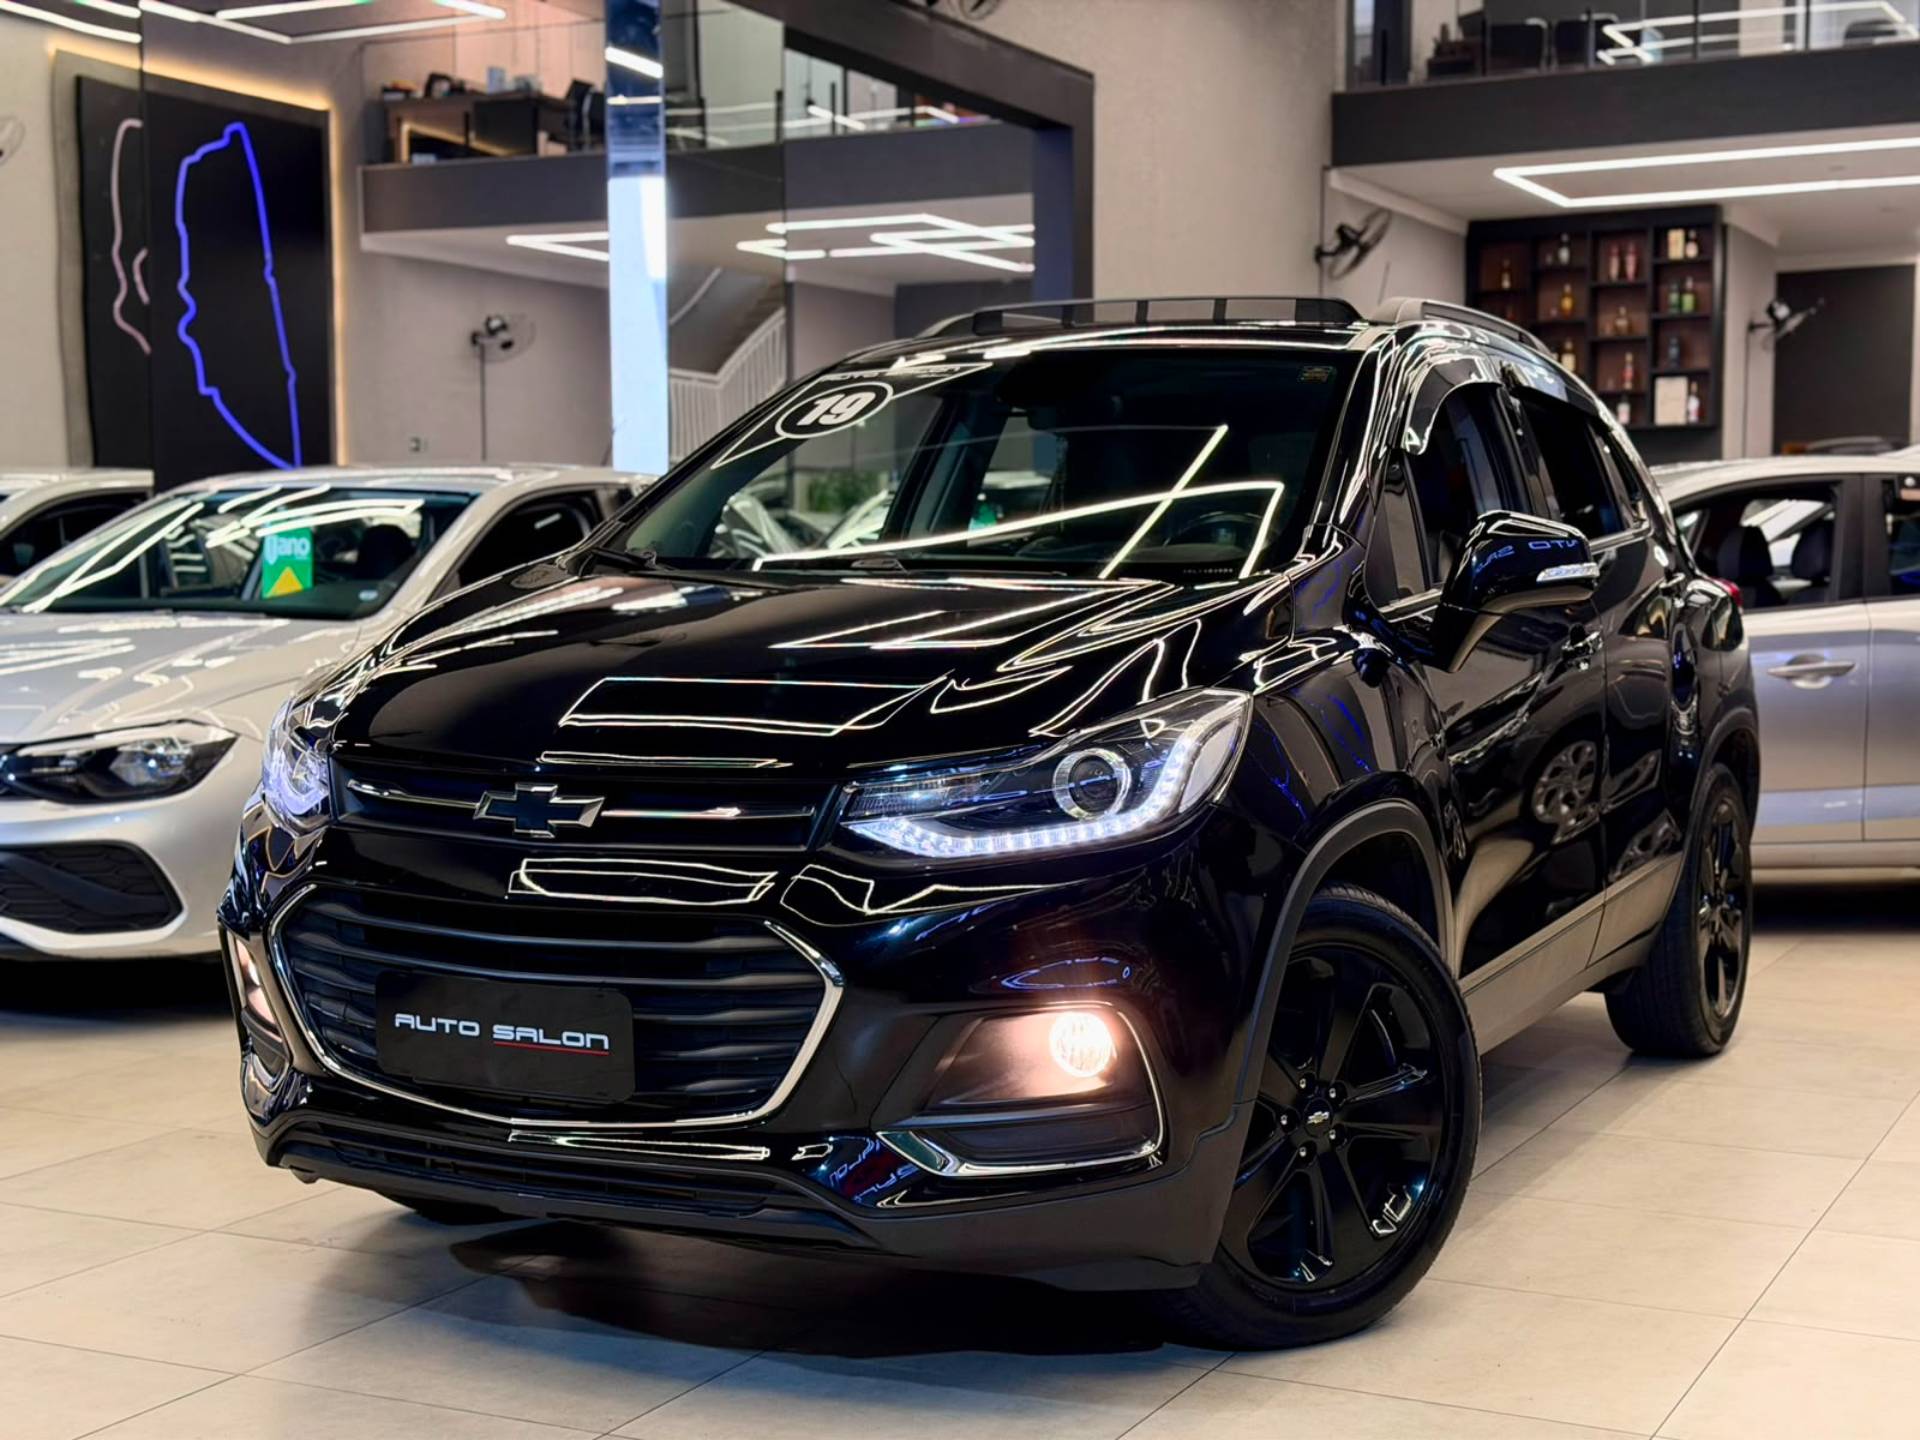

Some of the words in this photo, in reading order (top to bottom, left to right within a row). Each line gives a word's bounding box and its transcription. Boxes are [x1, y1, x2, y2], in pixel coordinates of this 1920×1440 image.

[797, 391, 876, 426] 19
[395, 1013, 480, 1037] AUTO
[493, 1024, 609, 1050] SALON
